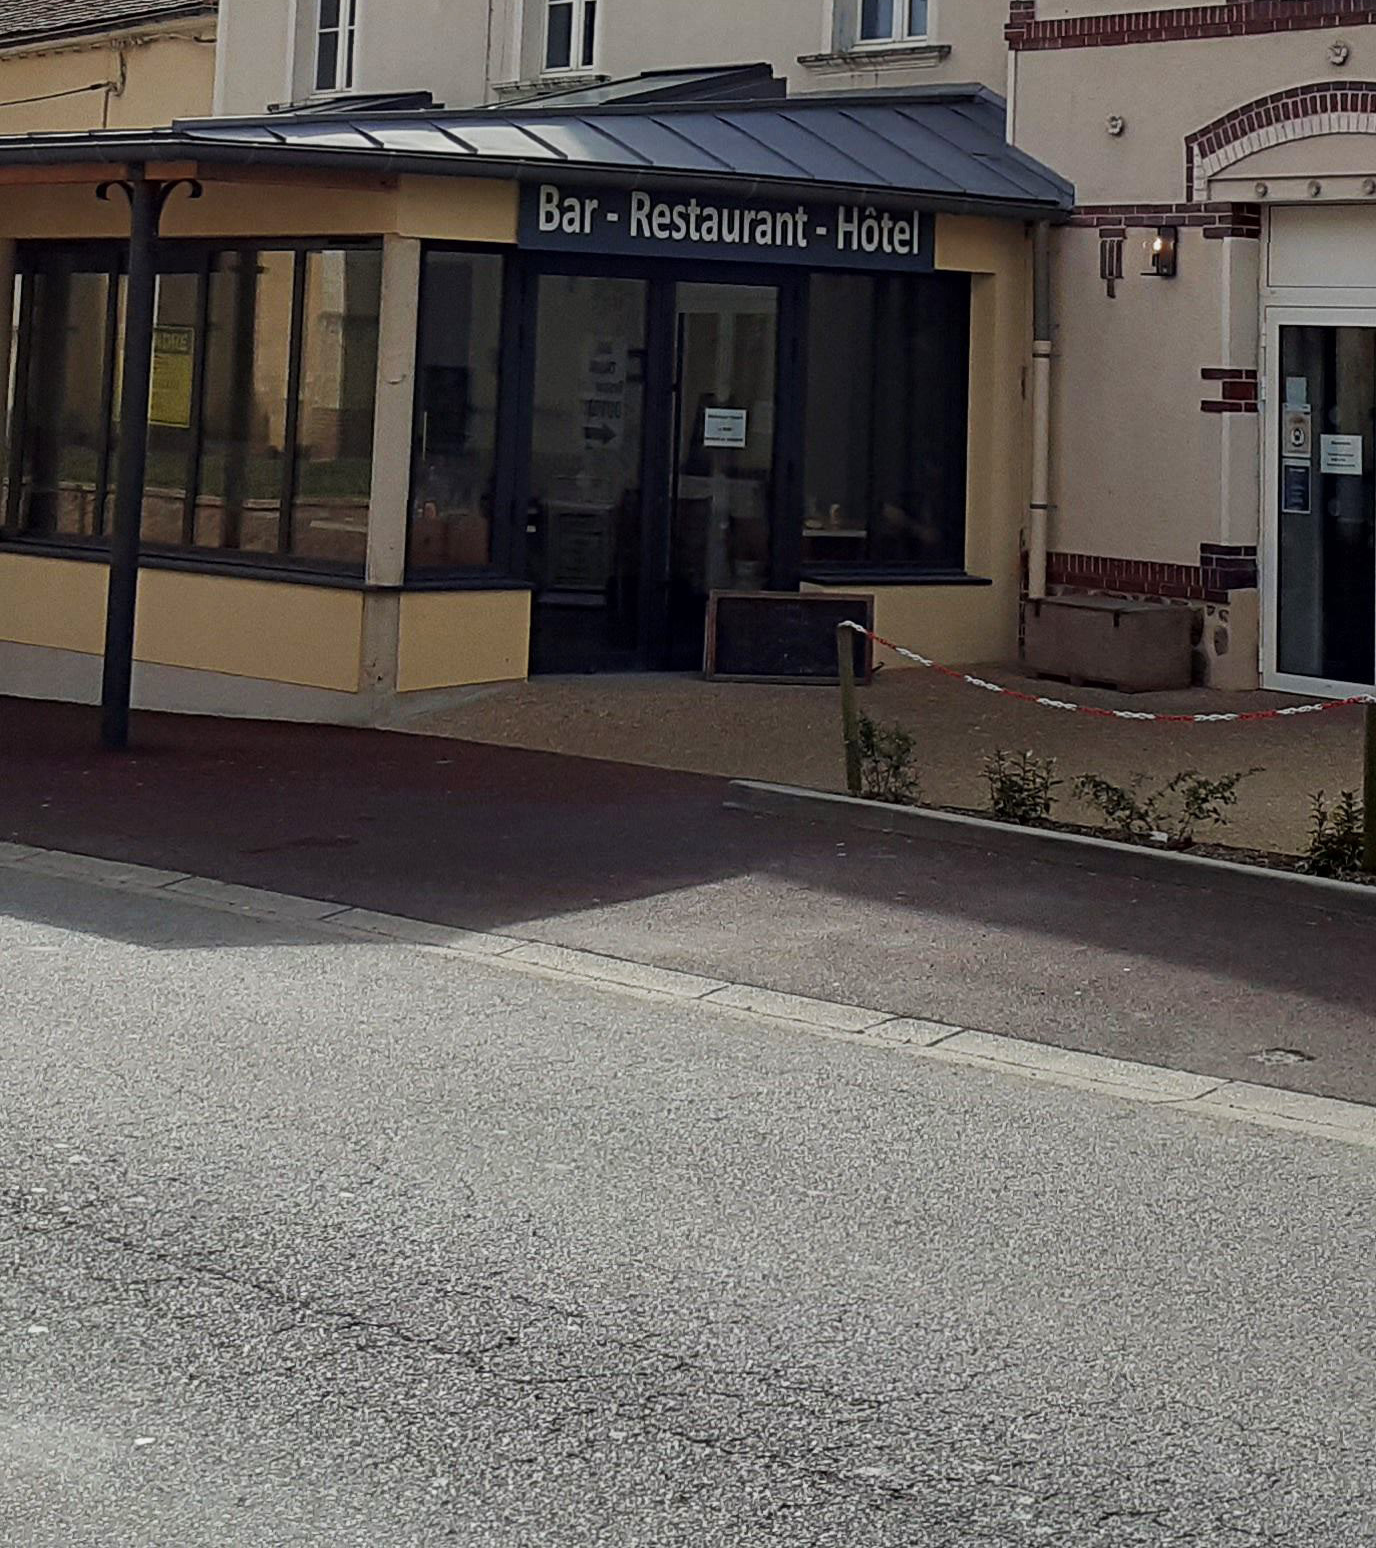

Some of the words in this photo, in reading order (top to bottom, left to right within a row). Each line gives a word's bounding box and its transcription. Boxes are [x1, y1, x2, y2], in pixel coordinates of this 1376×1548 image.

[538, 184, 599, 234] Bar
[629, 191, 809, 247] Restaurant
[837, 205, 920, 254] Hôtel
